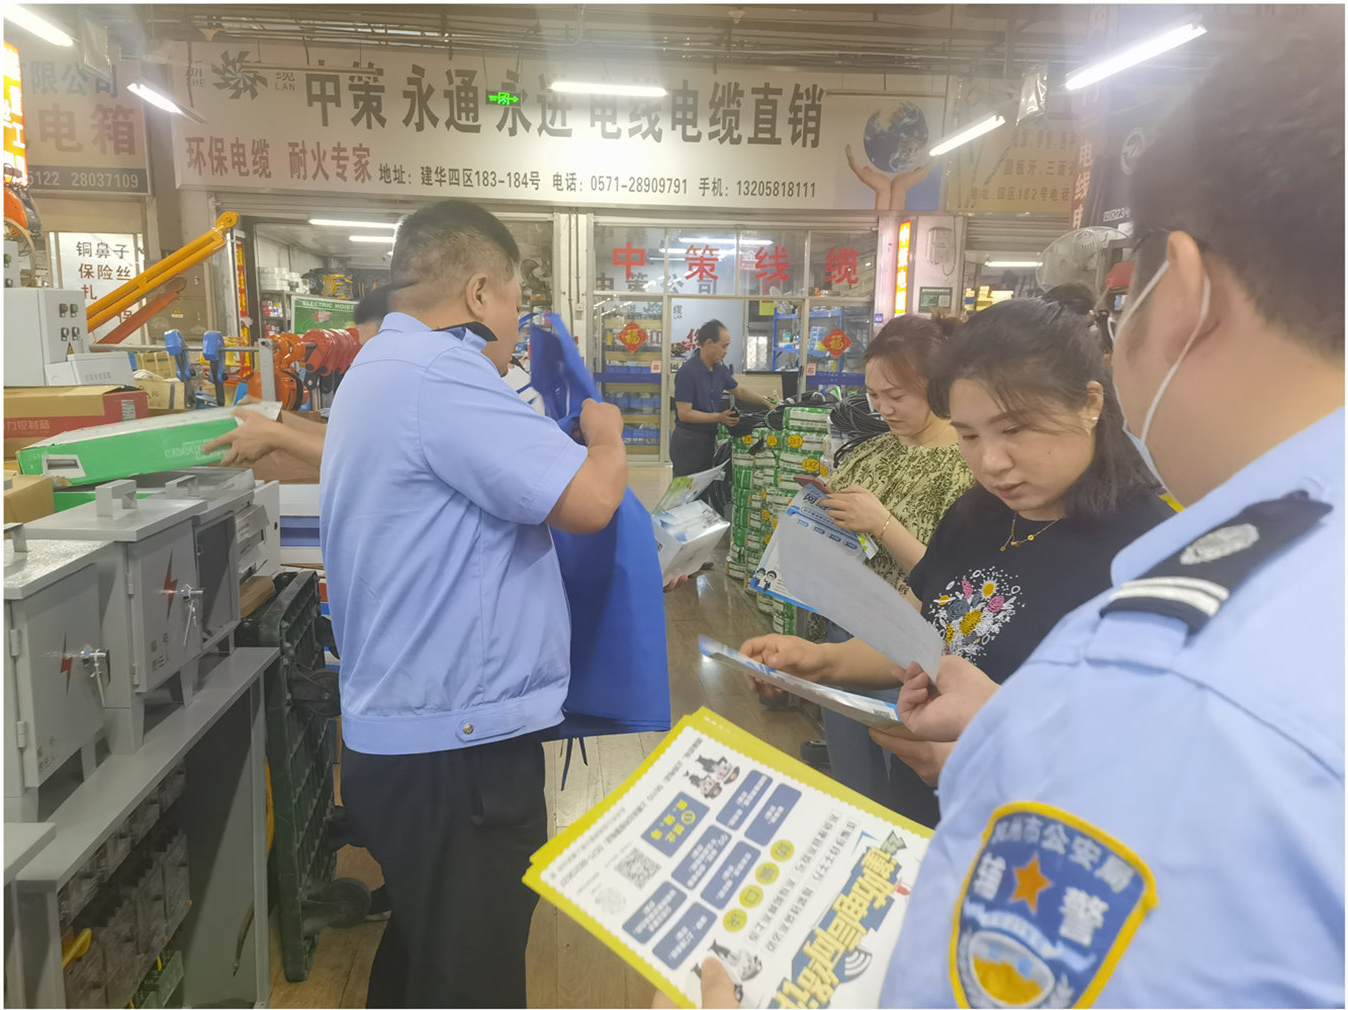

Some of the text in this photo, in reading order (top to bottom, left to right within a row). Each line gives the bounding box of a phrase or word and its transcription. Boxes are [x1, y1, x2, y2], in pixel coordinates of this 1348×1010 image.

[275, 82, 296, 91] LAN
[305, 59, 388, 130] 中策
[402, 63, 482, 134] 永通
[589, 78, 825, 149] 电线电缆直销
[185, 136, 373, 184] 环保电缆 耐火专家
[70, 171, 139, 189] 28037109
[420, 166, 542, 191] 建华四区183-184号
[590, 175, 688, 195] 0571-28909791
[736, 179, 816, 198] 13205818111
[76, 240, 130, 259] 铜鼻子
[78, 262, 132, 281] 保险丝
[612, 241, 861, 285] 中策线缆
